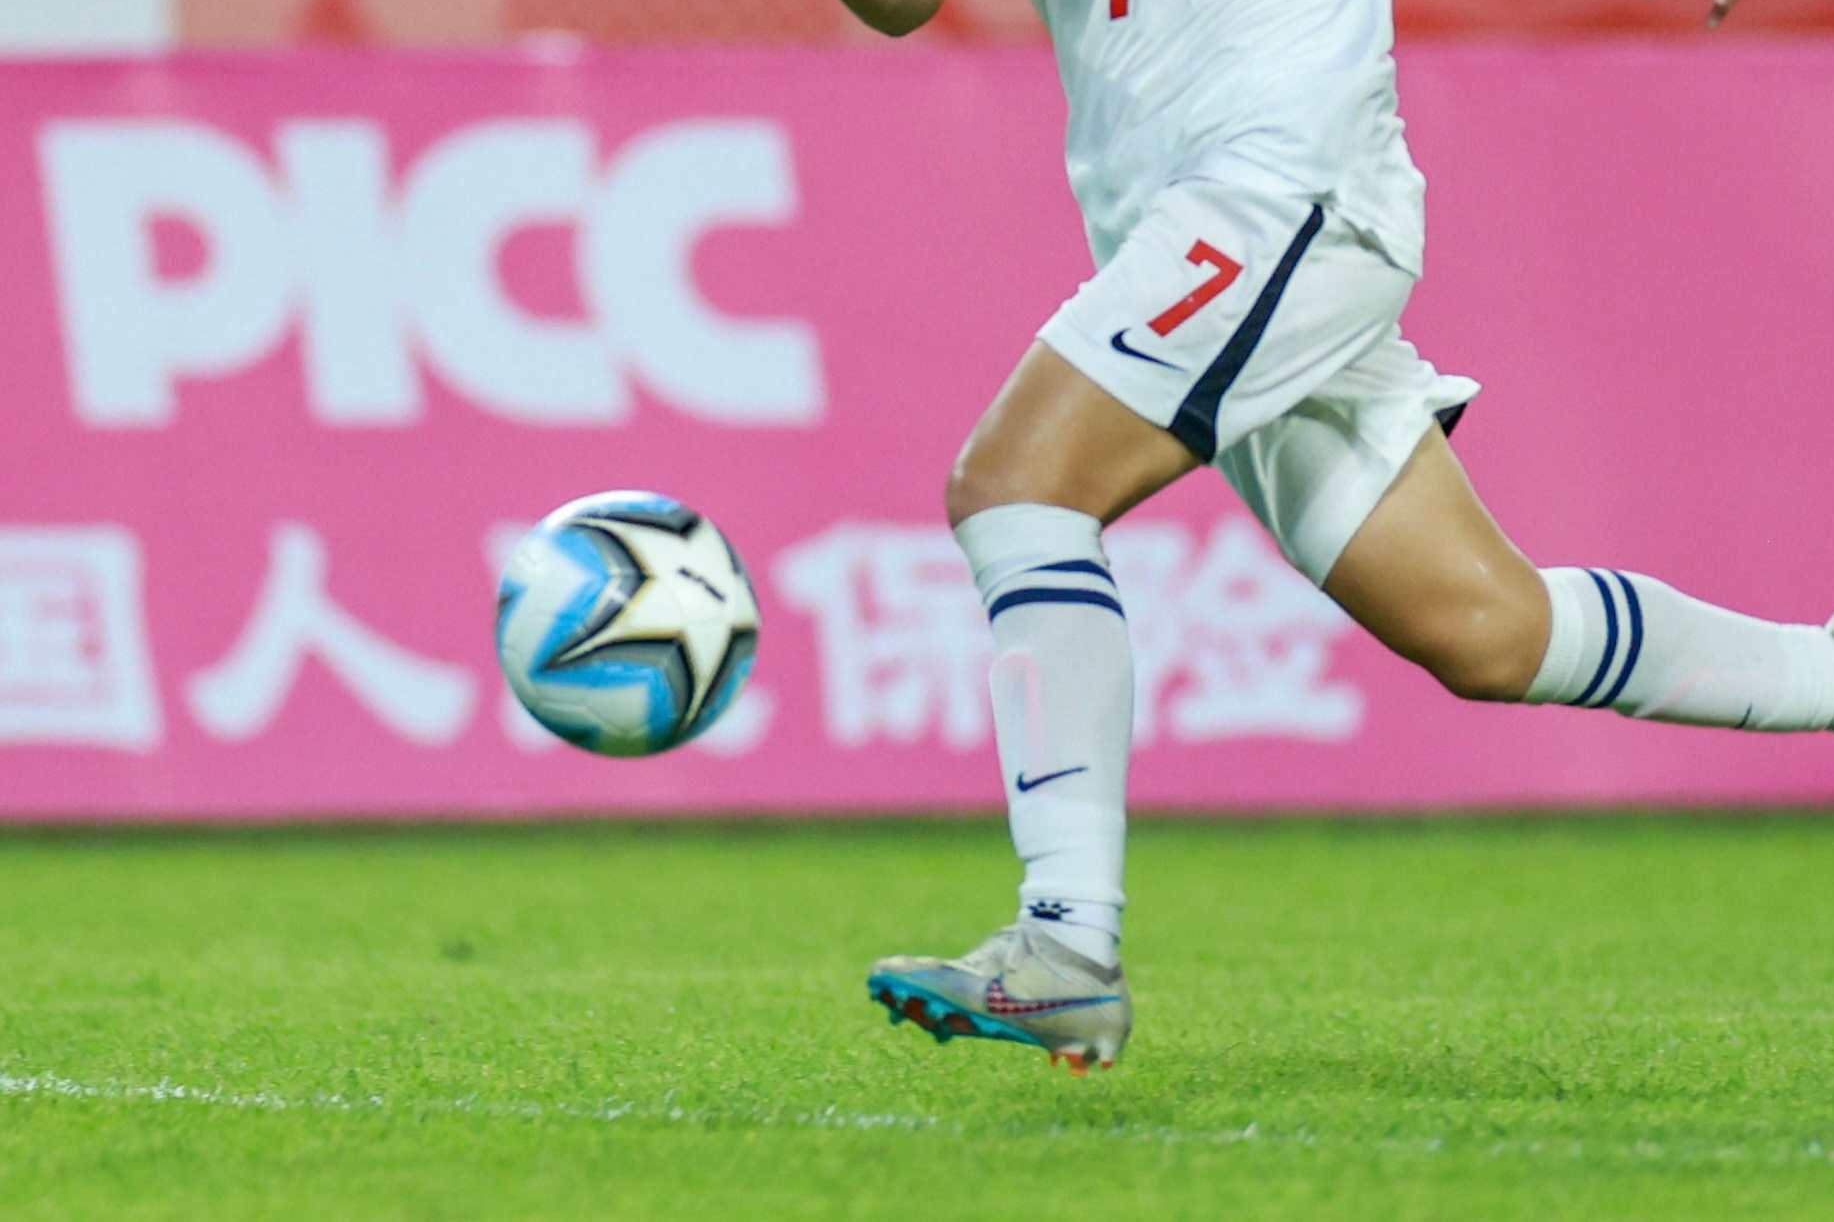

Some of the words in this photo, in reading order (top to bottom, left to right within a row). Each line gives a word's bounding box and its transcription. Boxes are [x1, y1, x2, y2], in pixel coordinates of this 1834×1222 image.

[34, 113, 830, 430] PICC
[1148, 239, 1243, 337] 7
[0, 518, 1366, 758] 国人保险
